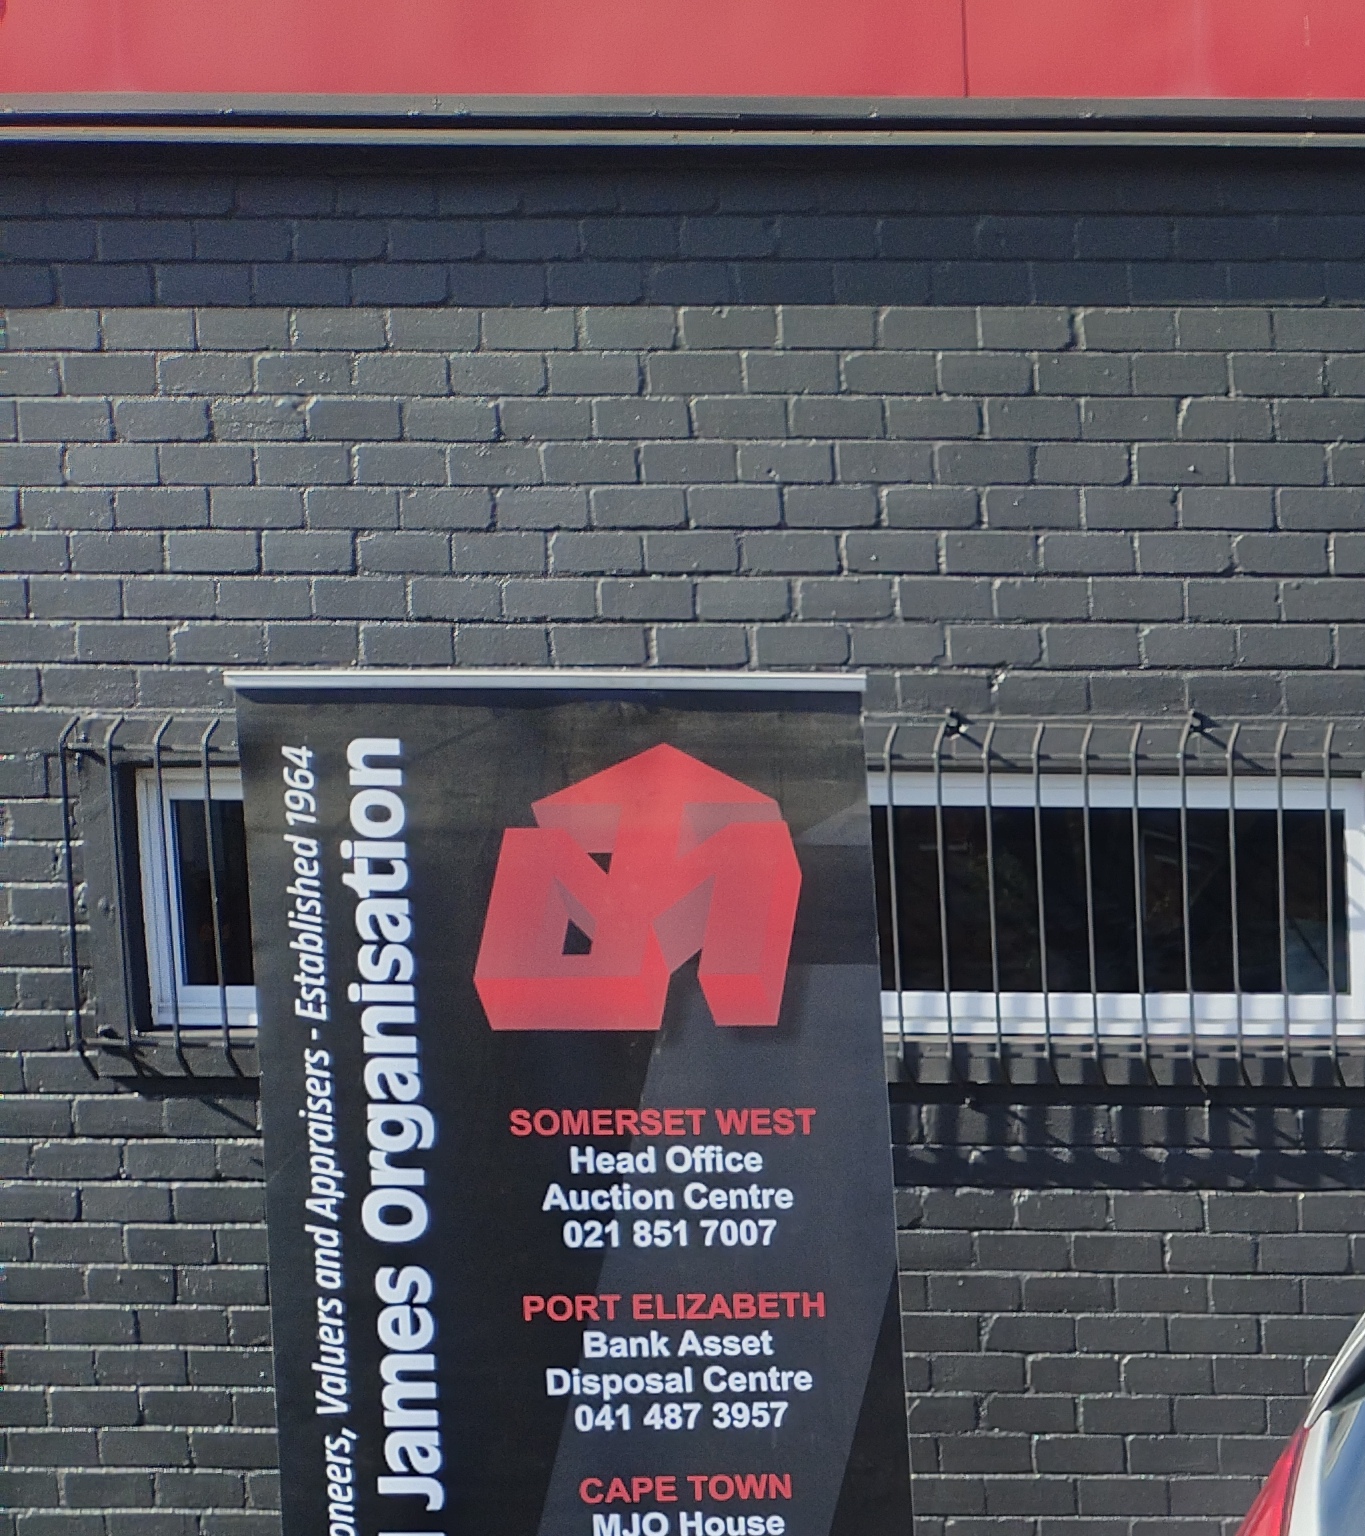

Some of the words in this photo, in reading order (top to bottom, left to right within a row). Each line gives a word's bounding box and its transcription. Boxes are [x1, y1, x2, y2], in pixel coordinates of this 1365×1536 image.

[281, 745, 317, 826] 1964
[283, 833, 328, 1021] Established
[339, 737, 435, 1243] Organisation
[298, 1048, 345, 1221] Appraisers
[510, 1108, 707, 1136] SOMERSET
[715, 1107, 817, 1136] WEST
[570, 1145, 657, 1174] Head
[665, 1145, 763, 1174] Office
[542, 1182, 675, 1211] Auction
[683, 1182, 794, 1210] Centre
[563, 1219, 620, 1248] 021
[633, 1219, 688, 1248] 851
[699, 1219, 777, 1247] 7007
[304, 1223, 342, 1290] and
[522, 1294, 621, 1322] PORT
[632, 1291, 826, 1320] ELIZABETH
[311, 1296, 349, 1415] Valuers
[583, 1330, 671, 1359] Bank
[677, 1329, 774, 1357] Asset
[374, 1265, 445, 1511] James
[546, 1366, 693, 1401] Disposal
[703, 1365, 813, 1393] Centre
[574, 1403, 631, 1432] 041
[643, 1402, 702, 1430] 487
[712, 1401, 789, 1429] 3957
[579, 1475, 678, 1504] CAPE
[687, 1473, 792, 1501] TOWN
